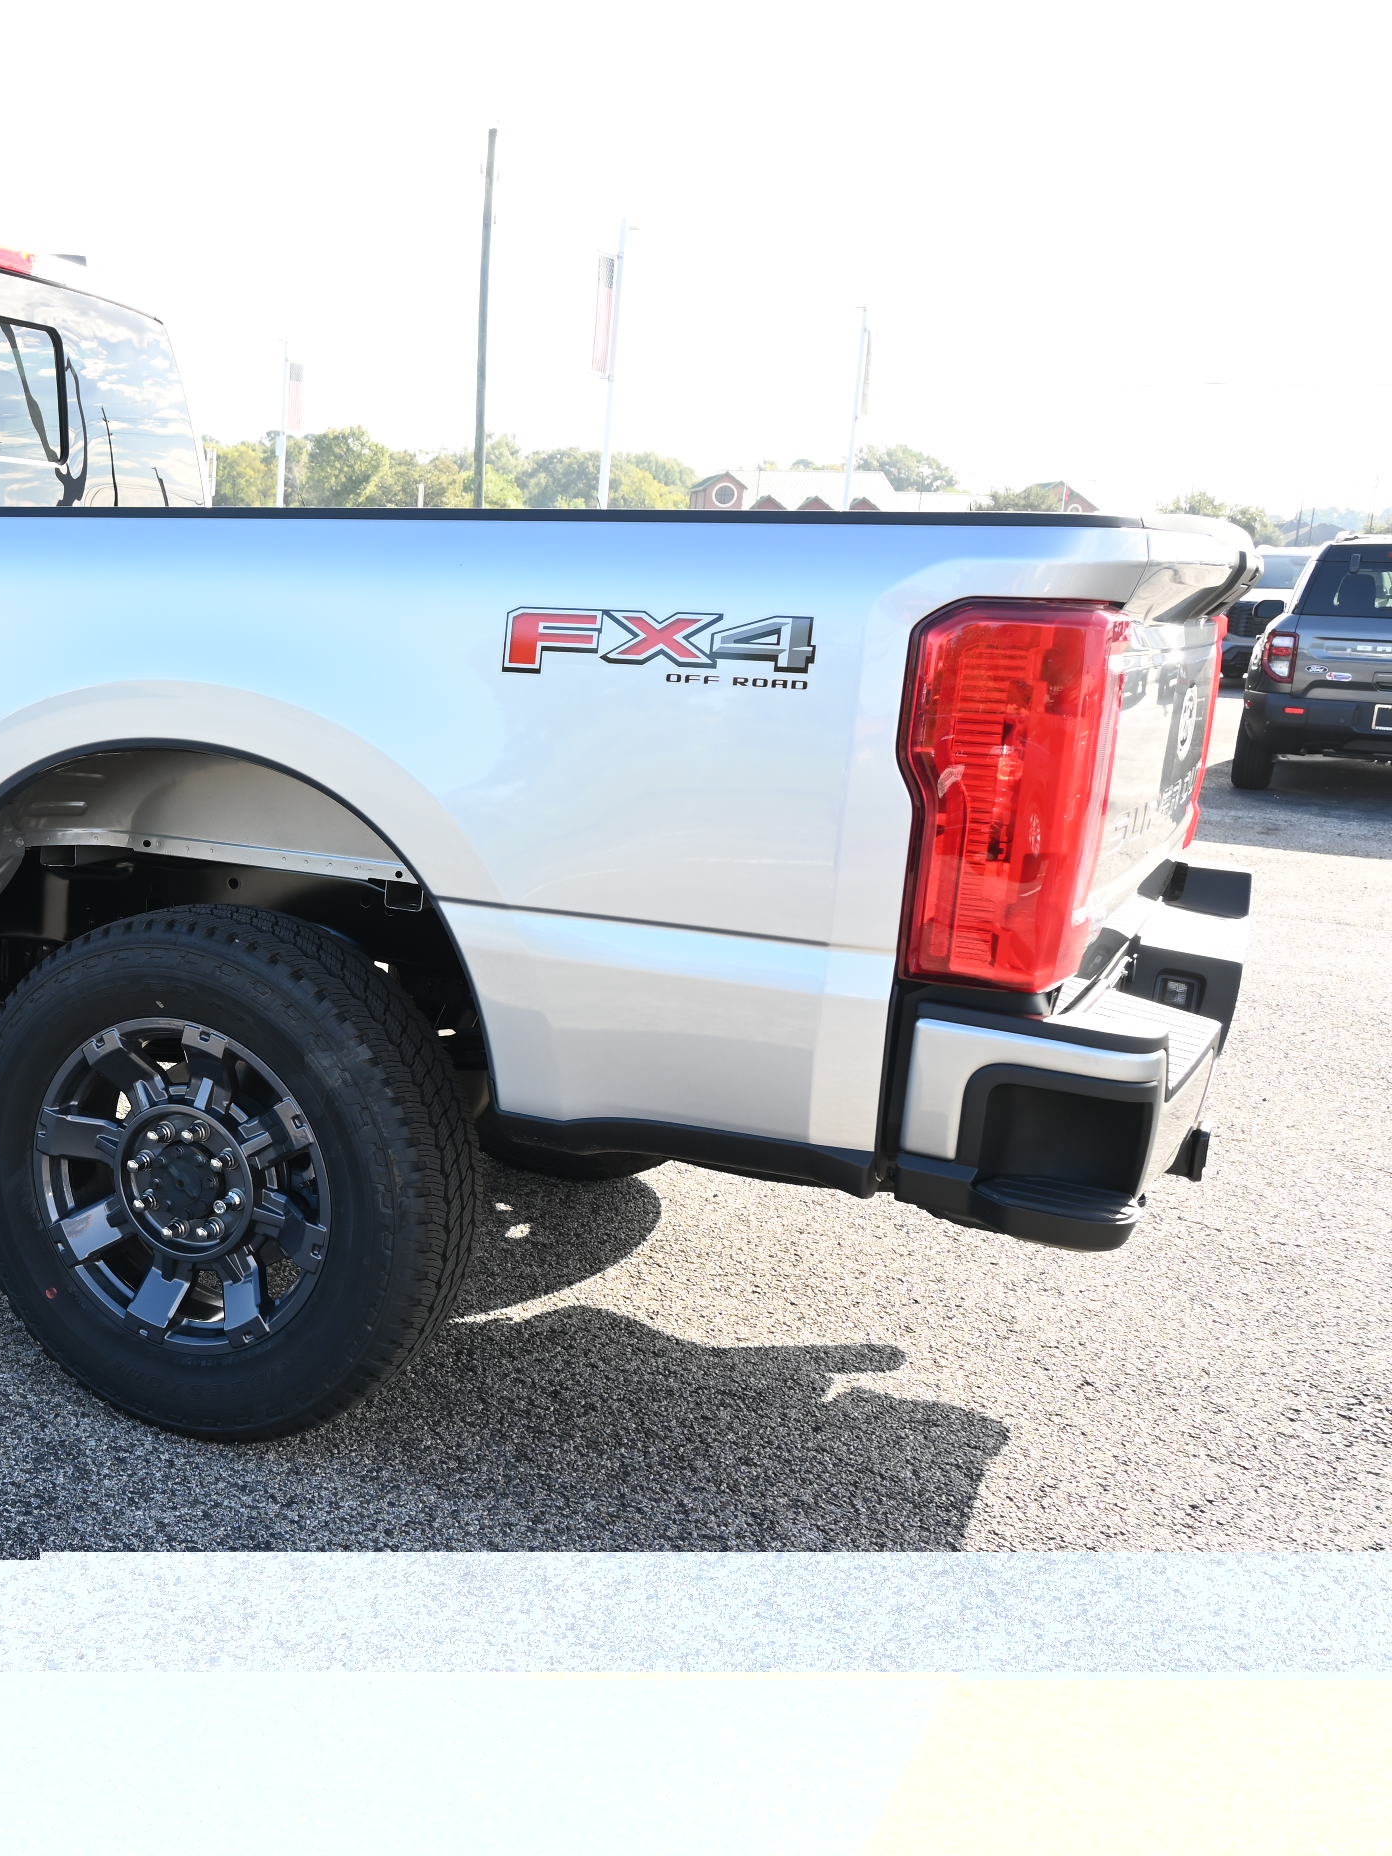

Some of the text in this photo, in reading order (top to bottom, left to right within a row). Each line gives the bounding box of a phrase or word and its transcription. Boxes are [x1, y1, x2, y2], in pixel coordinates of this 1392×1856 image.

[502, 606, 817, 674] FX4
[665, 673, 808, 690] OFF ROAD
